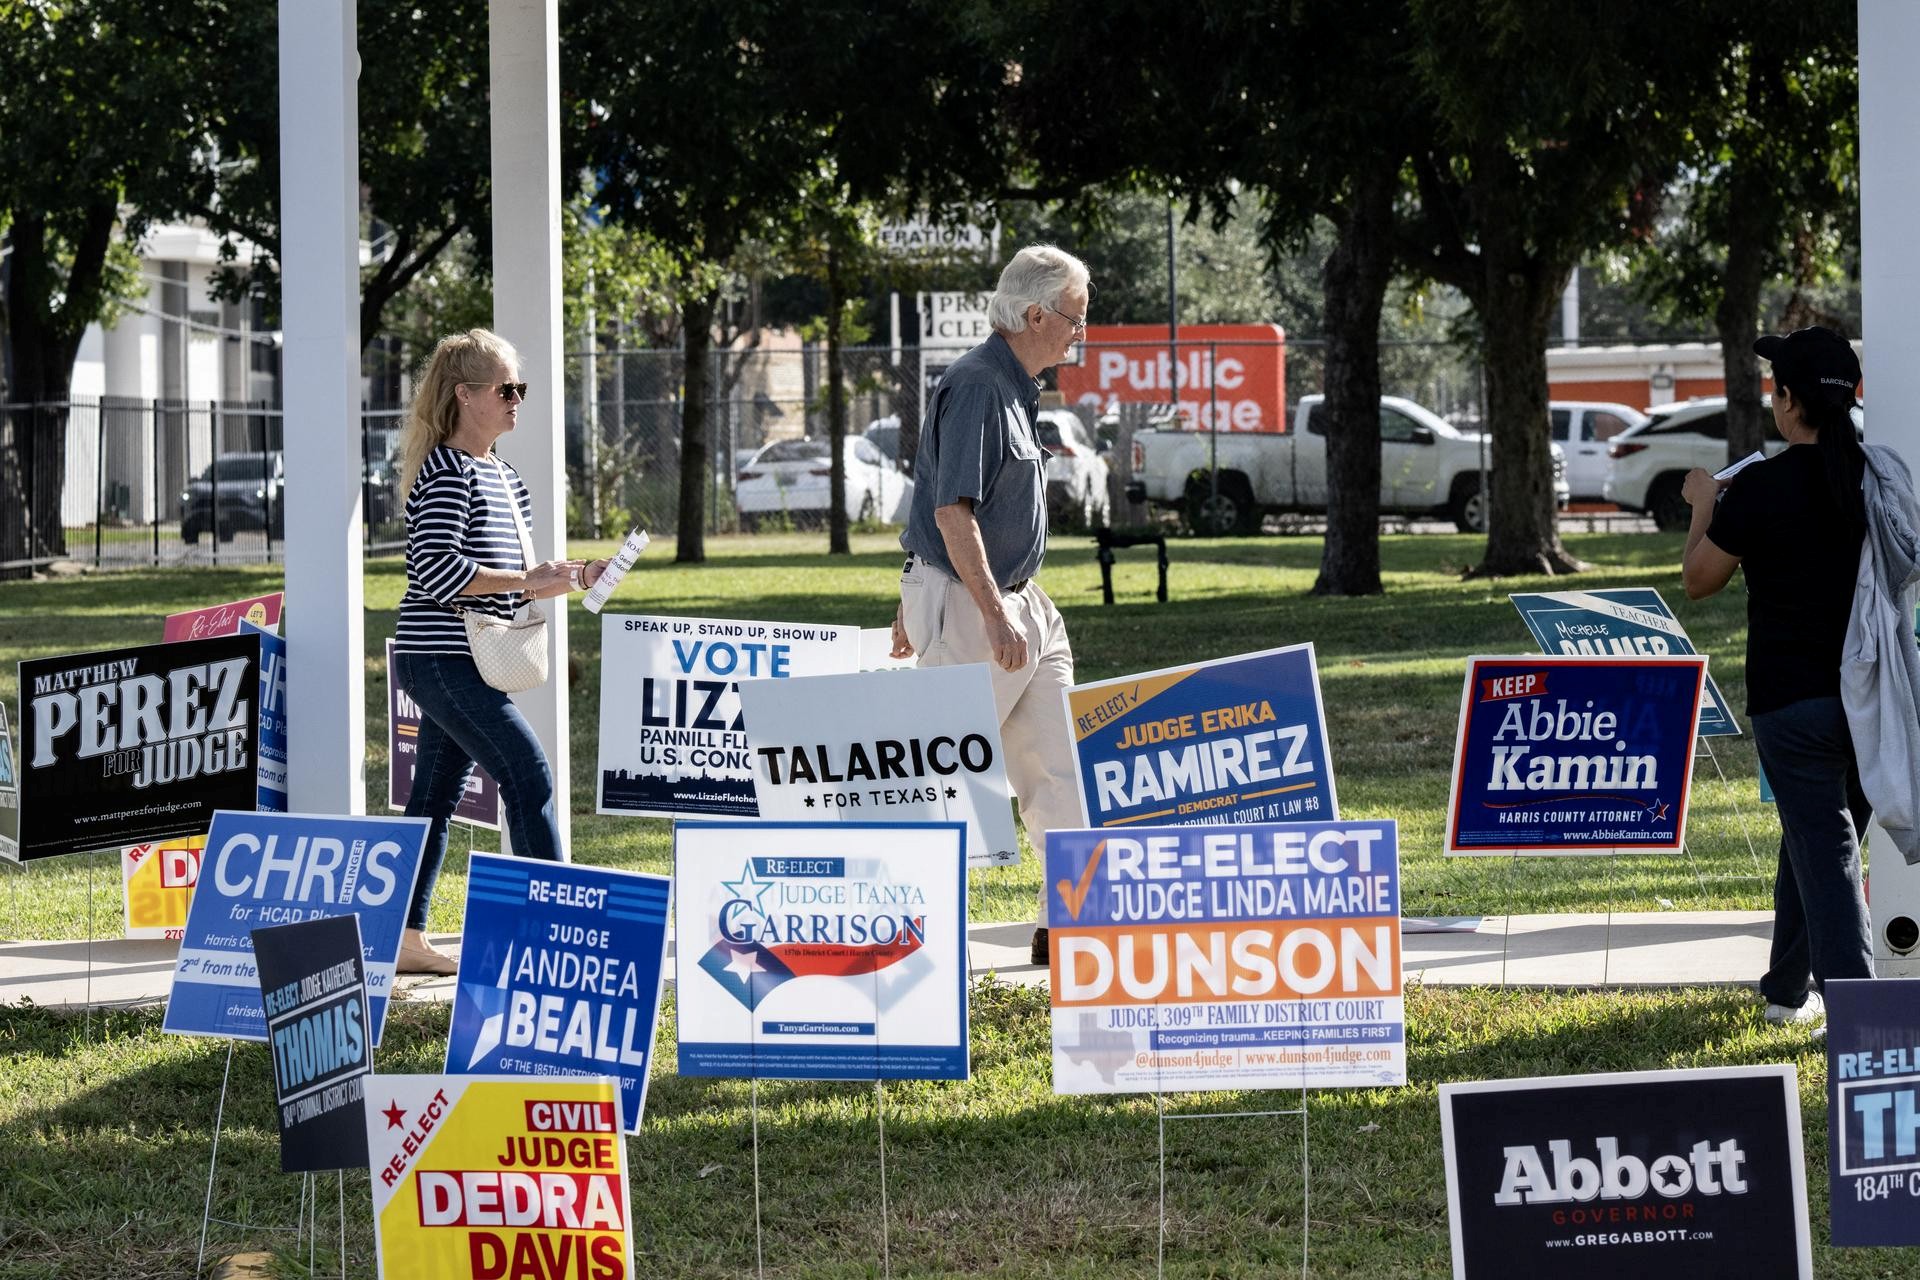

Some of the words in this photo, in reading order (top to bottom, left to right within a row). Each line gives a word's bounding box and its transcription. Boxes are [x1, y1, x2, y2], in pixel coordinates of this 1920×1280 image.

[1099, 351, 1244, 390] Public
[625, 620, 669, 633] SPEAK
[674, 623, 693, 635] UP,
[699, 624, 743, 636] STAND
[748, 627, 767, 640] UP,
[773, 628, 815, 641] SHOW
[820, 631, 838, 642] UP
[1610, 605, 1669, 631] TEACHER
[672, 640, 791, 678] VOTE
[34, 658, 139, 695] MATTHEW
[1492, 673, 1537, 698] KEEP
[30, 656, 251, 770] PEREZ
[1077, 692, 1129, 734] RE-ELECT
[1115, 714, 1197, 750] JUDGE
[1200, 700, 1277, 734] ERIKA
[1493, 699, 1617, 741] Abbie
[640, 729, 716, 748] PANNILL
[102, 751, 141, 778] FOR
[131, 727, 248, 790] JUDGE
[641, 747, 682, 765] U.S.
[757, 732, 993, 785] TALARICO
[1093, 723, 1315, 813] RAMIREZ
[1487, 740, 1658, 791] Kamin
[74, 800, 202, 826] www.mattperezforjudge.com
[823, 791, 866, 808] FOR
[873, 787, 938, 805] TEXAS
[1177, 794, 1240, 815] DEMOCRAT
[1233, 806, 1265, 824] COURT
[1268, 803, 1280, 818] AT
[1283, 800, 1302, 817] LAW
[1305, 796, 1320, 811] #8
[1499, 811, 1540, 824] HARRIS
[1543, 811, 1586, 823] COUNTY
[1588, 810, 1643, 823] ATTORNEY
[1563, 829, 1673, 841] www.AbbieKamin.com
[341, 839, 364, 903] EHLINGER
[766, 859, 833, 874] RE-ELECT
[1106, 828, 1383, 881] RE-ELECT
[528, 879, 608, 910] RE-ELECT
[779, 882, 847, 909] JUDGE
[853, 881, 927, 905] TANYA
[1110, 881, 1204, 921] JUDGE
[1211, 878, 1297, 919] LINDA
[1304, 875, 1391, 915] MARIE
[229, 904, 254, 922] for
[259, 907, 302, 925] HCAD
[718, 899, 928, 946] GARRISON
[204, 934, 239, 949] Harris
[549, 923, 610, 949] JUDGE
[180, 957, 201, 973] 2nd
[202, 959, 234, 977] from
[235, 962, 256, 977] the
[514, 946, 639, 1000] ANDREA
[1059, 926, 1393, 1001] DUNSON
[265, 982, 300, 1018] RE-ELECT
[299, 971, 322, 1003] JUDGE
[321, 958, 357, 993] KATHERINE
[505, 990, 644, 1067] BEALL
[778, 1023, 860, 1034] TanyaGarrison.com
[1108, 1008, 1160, 1029] JUDGE,
[1208, 1003, 1260, 1026] FAMILY
[1264, 1001, 1329, 1023] DISTRICT
[1331, 1000, 1385, 1021] COURT
[274, 998, 364, 1090] THOMAS
[1158, 1034, 1219, 1047] Recognizing
[1312, 1028, 1360, 1040] FAMILIES
[1362, 1026, 1392, 1038] FIRST
[500, 1057, 513, 1070] OF
[514, 1060, 534, 1074] THE
[534, 1063, 560, 1077] 185TH
[1135, 1052, 1233, 1069] @dunson4judge
[1246, 1046, 1392, 1065] www.dunson4judge.com
[296, 1093, 323, 1123] CRIMINAL
[322, 1081, 349, 1112] DISTRICT
[531, 1102, 612, 1132] CIVIL
[381, 1089, 450, 1188] RE-ELECT
[498, 1136, 614, 1169] JUDGE
[1494, 1136, 1749, 1207] Abbott
[419, 1172, 624, 1231] DEDRA
[1552, 1203, 1696, 1226] GOVERNOR
[468, 1231, 625, 1280] DAVIS
